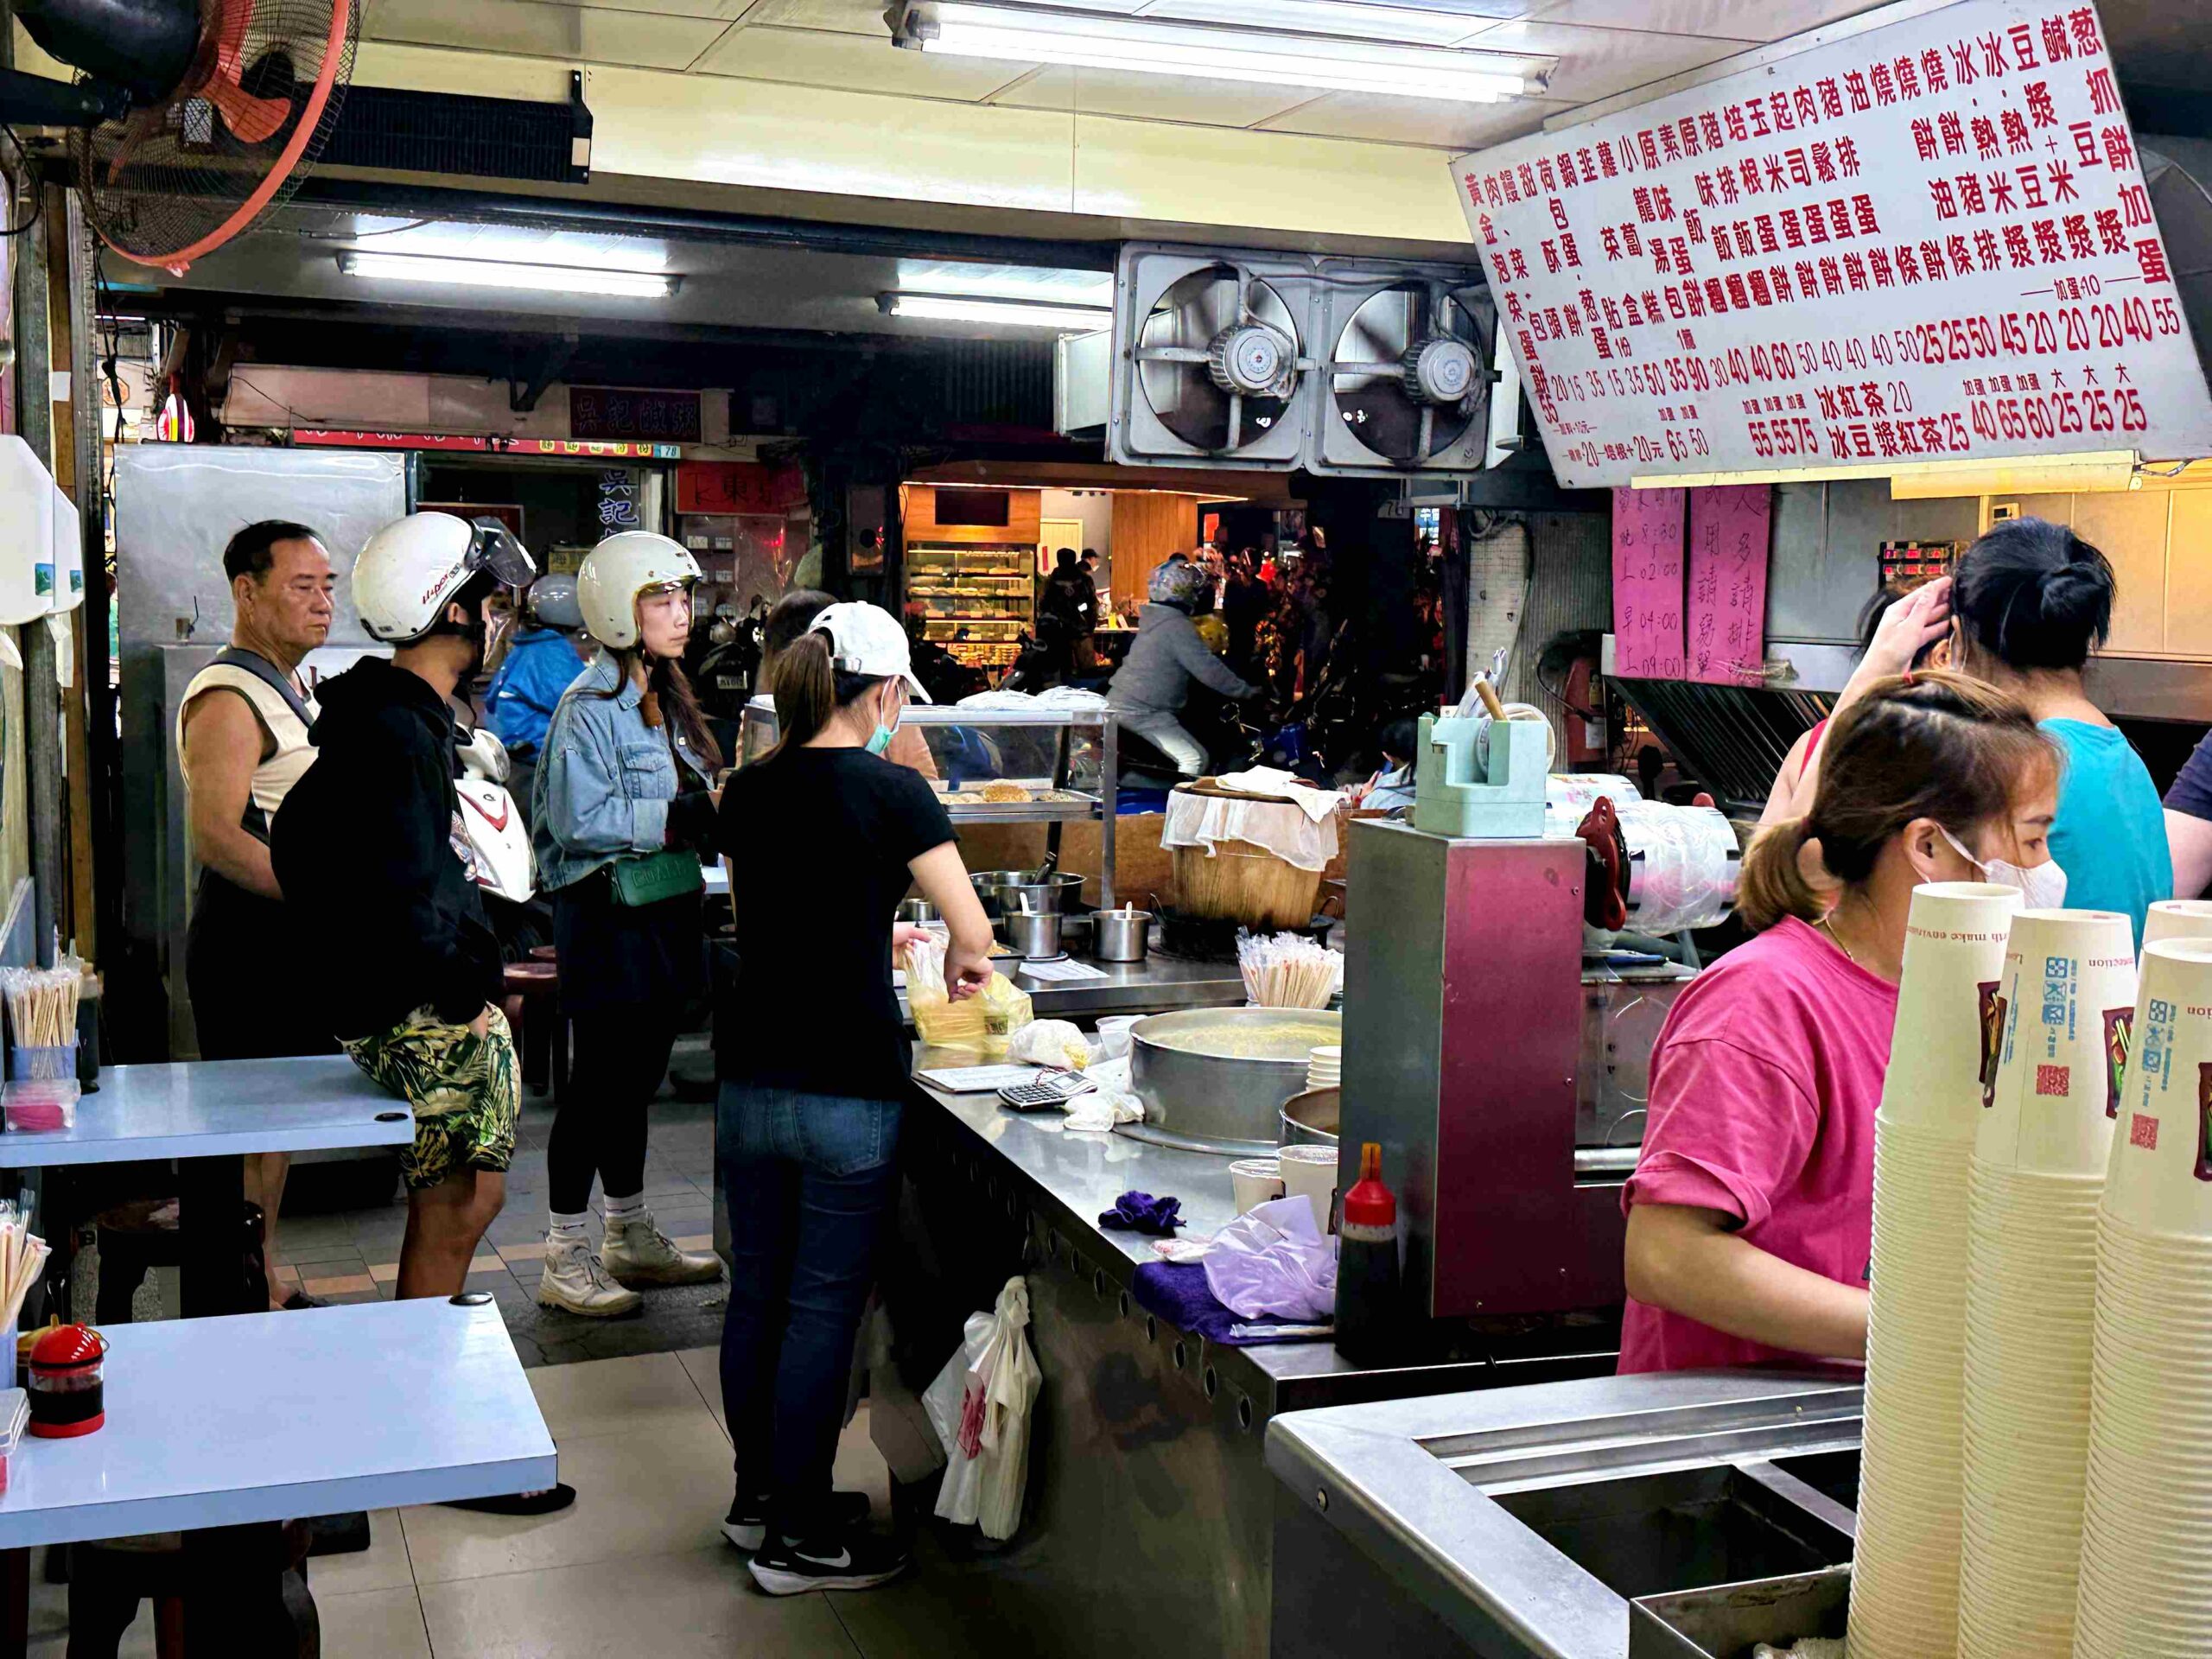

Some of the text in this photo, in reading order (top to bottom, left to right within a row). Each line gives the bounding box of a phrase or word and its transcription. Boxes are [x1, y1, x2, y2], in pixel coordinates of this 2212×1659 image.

[1999, 312, 2028, 355] 45
[2027, 310, 2057, 353] 20
[2059, 307, 2089, 351] 20
[2092, 303, 2124, 348] 20
[2123, 296, 2152, 342] 40
[2152, 298, 2180, 335] 55
[1847, 338, 1866, 370] 40
[1872, 334, 1893, 365] 40
[1894, 329, 1919, 362] 50
[1916, 323, 1944, 364] 25
[1942, 320, 1970, 359] 25
[1967, 315, 1996, 358] 50
[1686, 357, 1709, 391] 90
[1710, 358, 1729, 387] 30
[1728, 348, 1749, 385] 40
[1751, 345, 1772, 382] 40
[1772, 342, 1796, 379] 60
[1796, 341, 1818, 374] 50
[1822, 340, 1842, 372] 40
[1551, 374, 1568, 401] 20
[1567, 376, 1584, 401] 15
[1586, 371, 1605, 397] 35
[1607, 369, 1624, 396] 15
[1625, 366, 1644, 395] 35
[1643, 363, 1666, 396] 50
[1665, 358, 1688, 392] 35
[1539, 393, 1559, 424] 55
[1815, 381, 1912, 421] 冰紅茶 20
[2050, 369, 2082, 432] 大 25
[2082, 365, 2113, 430] 大 25
[2114, 363, 2146, 430] 大 25
[1771, 419, 1796, 454] 55
[1792, 417, 1819, 454] 75
[1827, 413, 1970, 460] 冰豆漿紅茶 25
[1971, 400, 1997, 441] 40
[1997, 399, 2026, 439] 65
[2024, 398, 2055, 438] 60
[1666, 429, 1688, 461] 65
[1688, 428, 1709, 455] 50
[1749, 423, 1773, 456] 55
